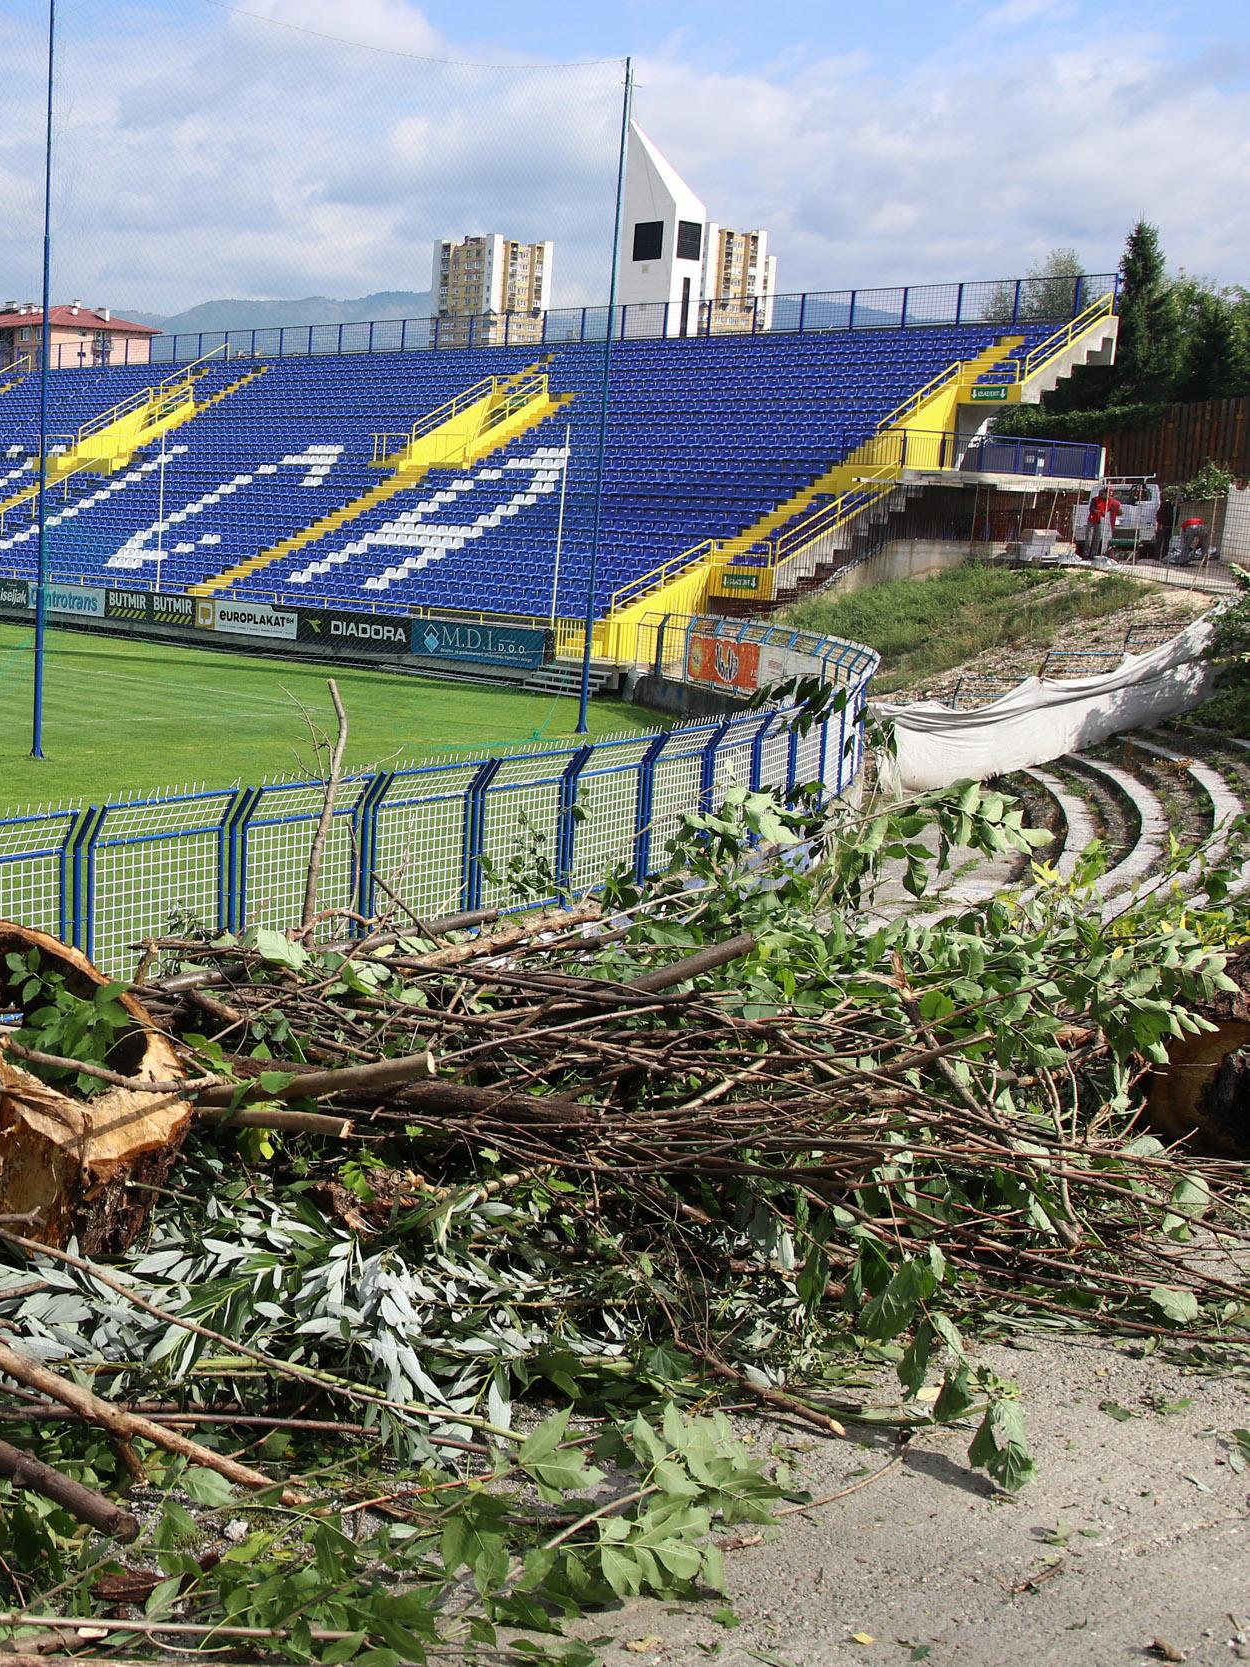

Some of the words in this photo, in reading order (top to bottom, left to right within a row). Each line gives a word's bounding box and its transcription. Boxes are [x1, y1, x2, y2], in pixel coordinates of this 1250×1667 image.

[109, 591, 146, 610] BUTMIR
[153, 596, 192, 615] BUTMIR
[330, 620, 407, 643] DIADORA
